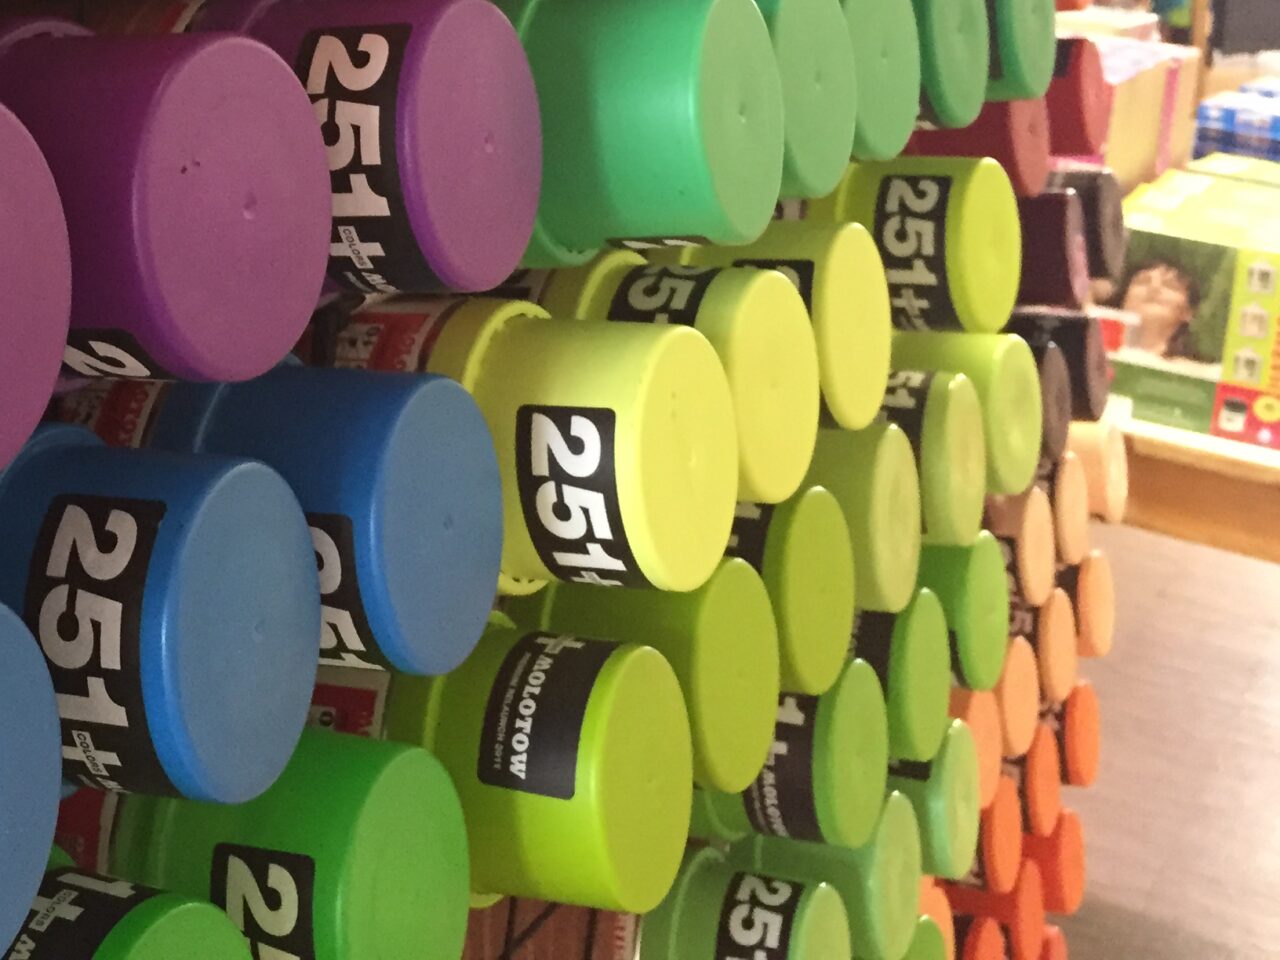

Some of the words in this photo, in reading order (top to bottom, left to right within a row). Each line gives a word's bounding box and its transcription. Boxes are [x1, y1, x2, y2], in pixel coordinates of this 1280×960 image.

[342, 228, 367, 267] COLORS
[508, 654, 555, 780] MOLOTOW
[76, 732, 103, 774] COLORS
